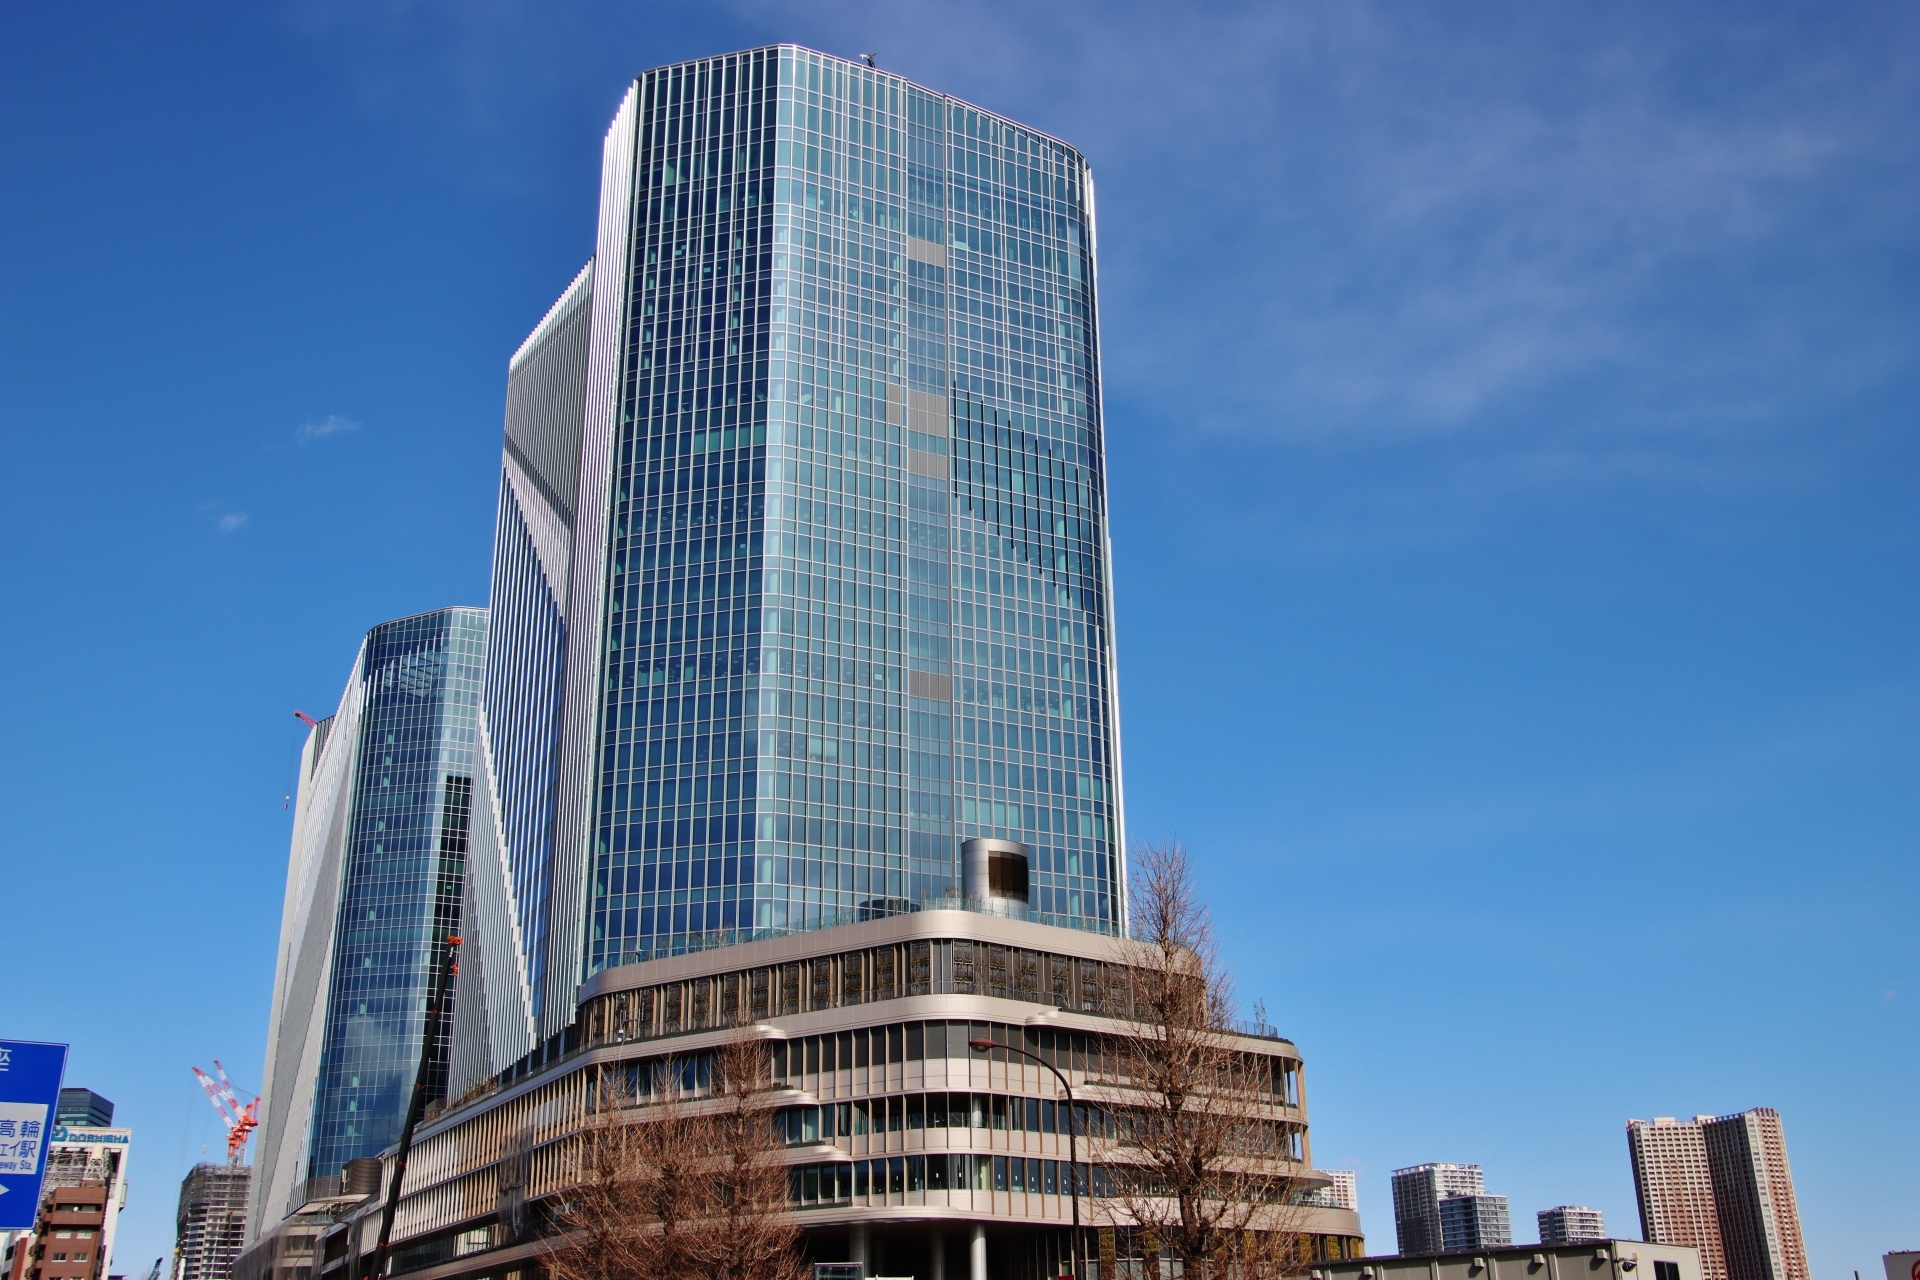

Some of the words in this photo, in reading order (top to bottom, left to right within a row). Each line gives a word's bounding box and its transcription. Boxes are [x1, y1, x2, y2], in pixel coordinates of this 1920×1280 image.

[0, 1119, 41, 1138] 高輪
[68, 1133, 129, 1143] DOSHISHA
[20, 1159, 32, 1170] Sta.
